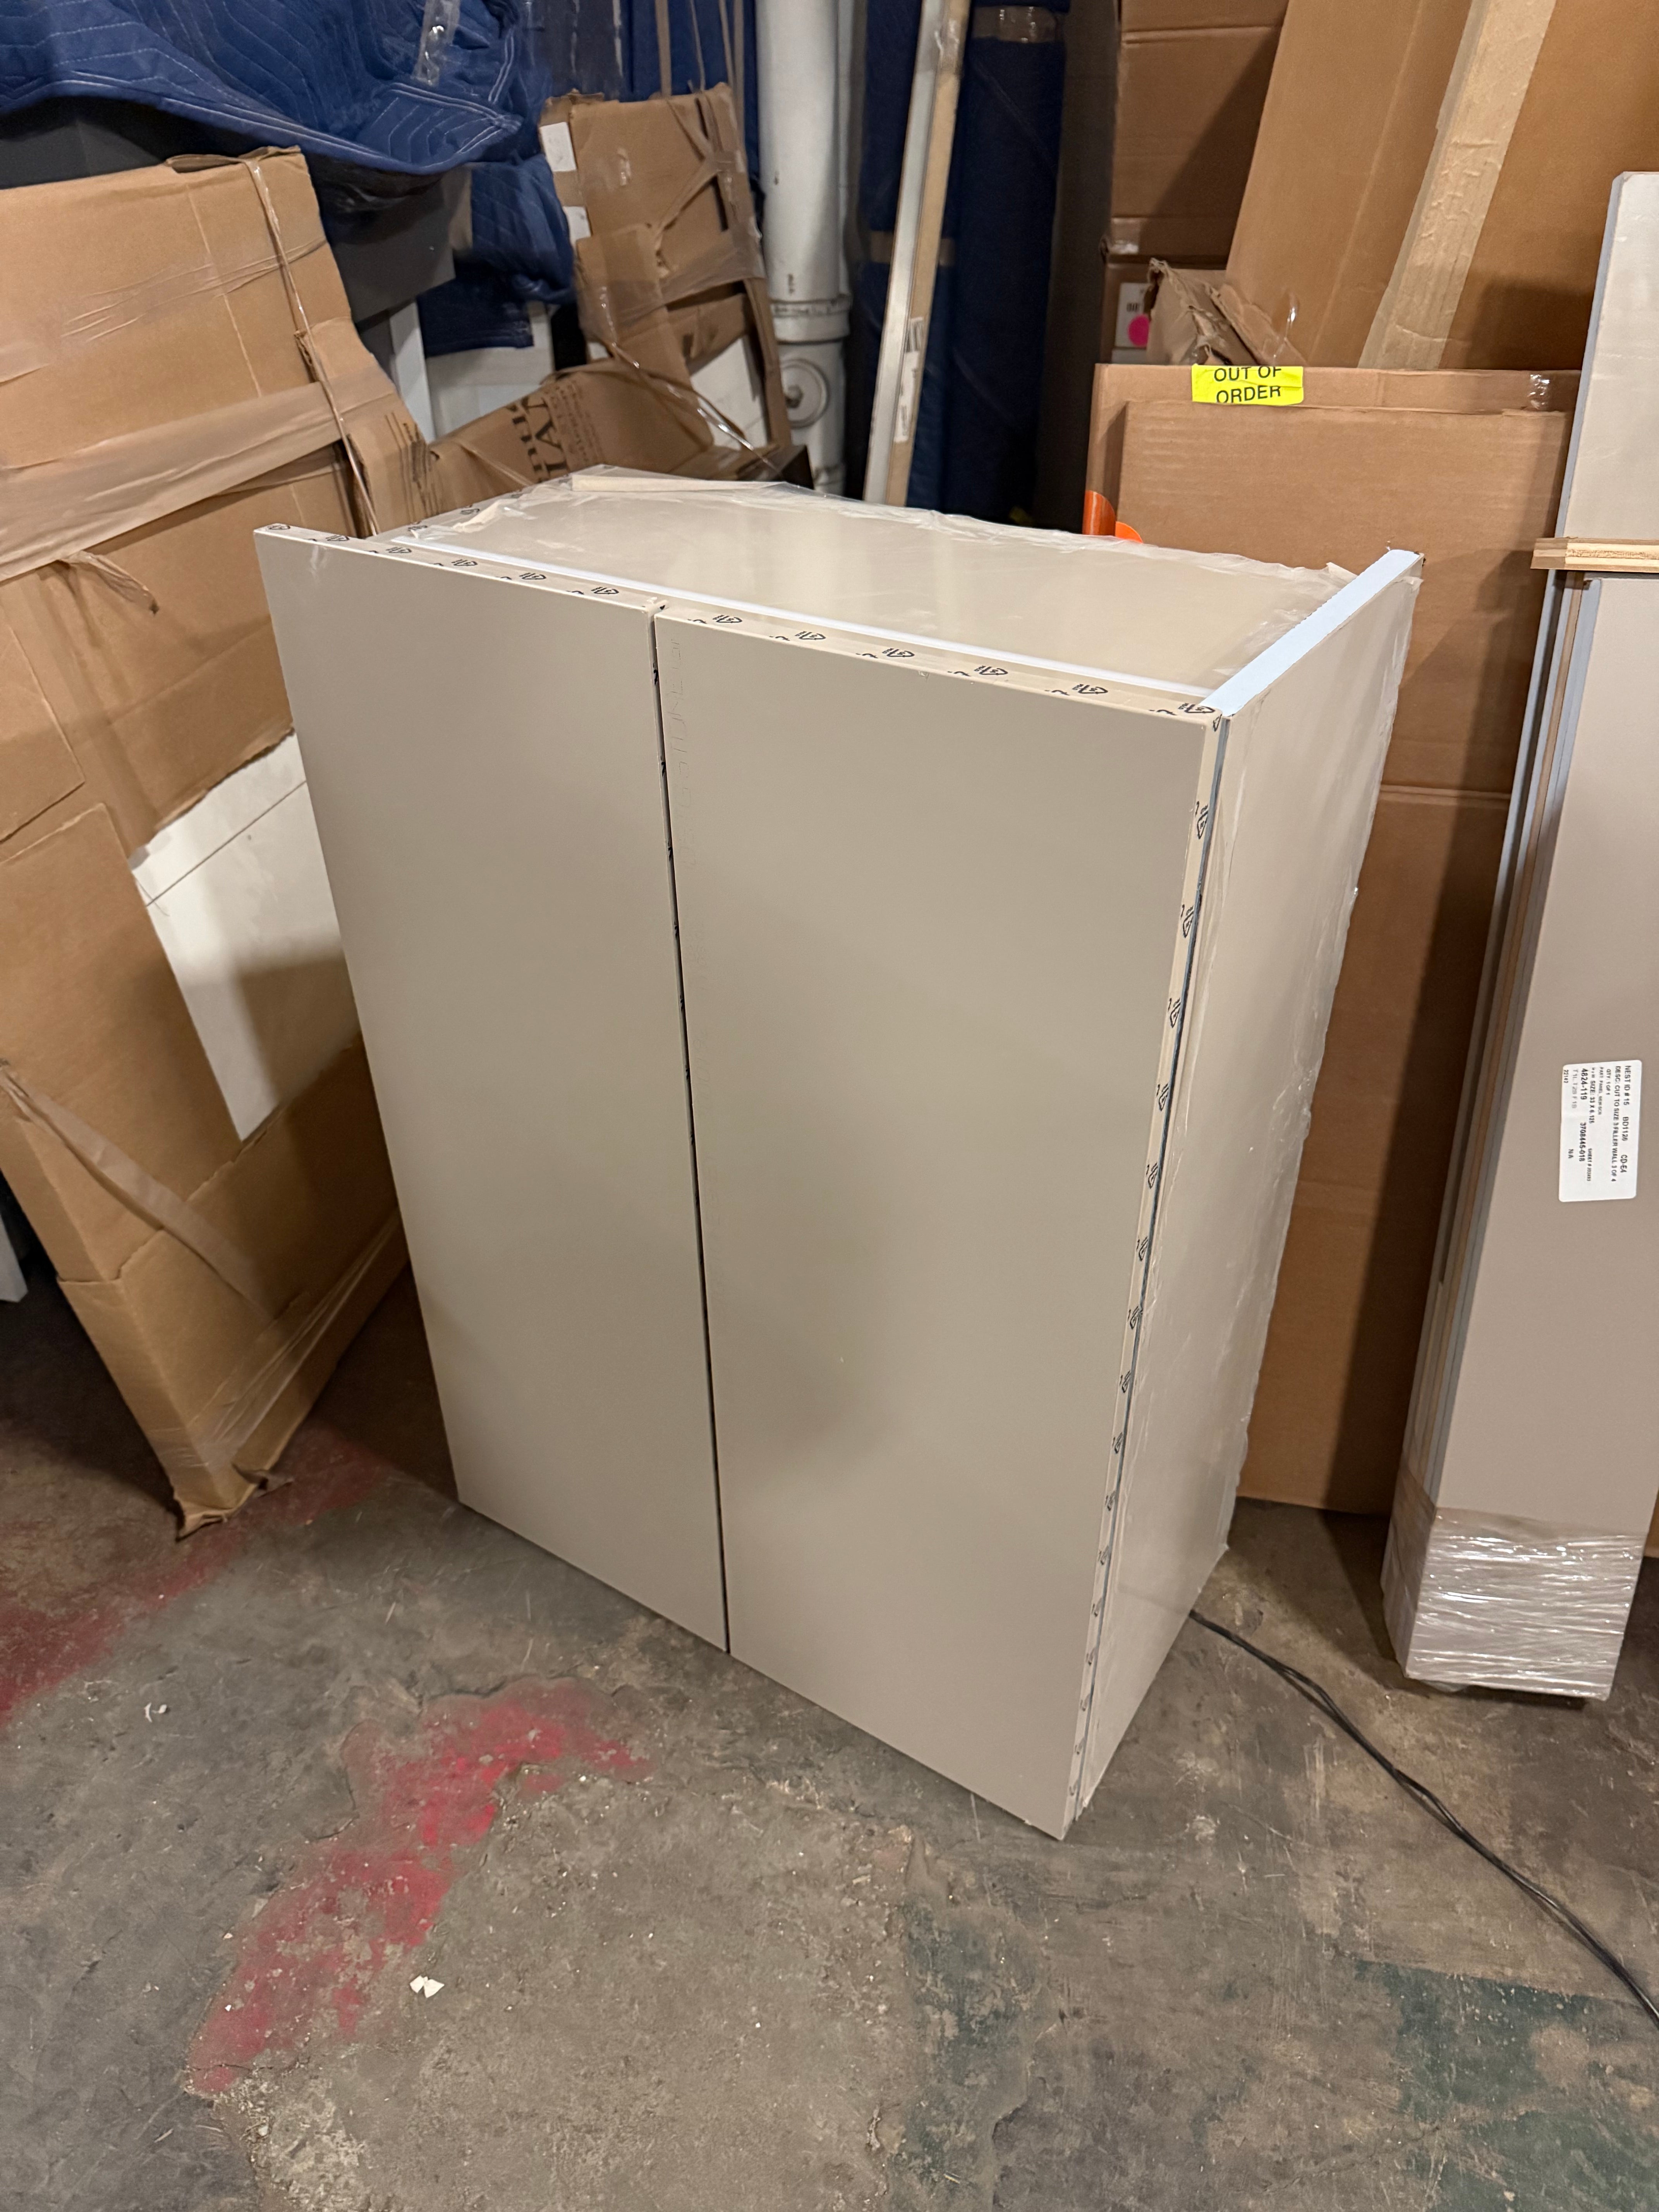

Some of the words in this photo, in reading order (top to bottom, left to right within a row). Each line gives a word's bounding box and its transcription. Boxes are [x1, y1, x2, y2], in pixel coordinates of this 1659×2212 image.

[1214, 367, 1251, 381] OUT
[1258, 366, 1281, 378] OF
[1216, 385, 1281, 403] ORDER
